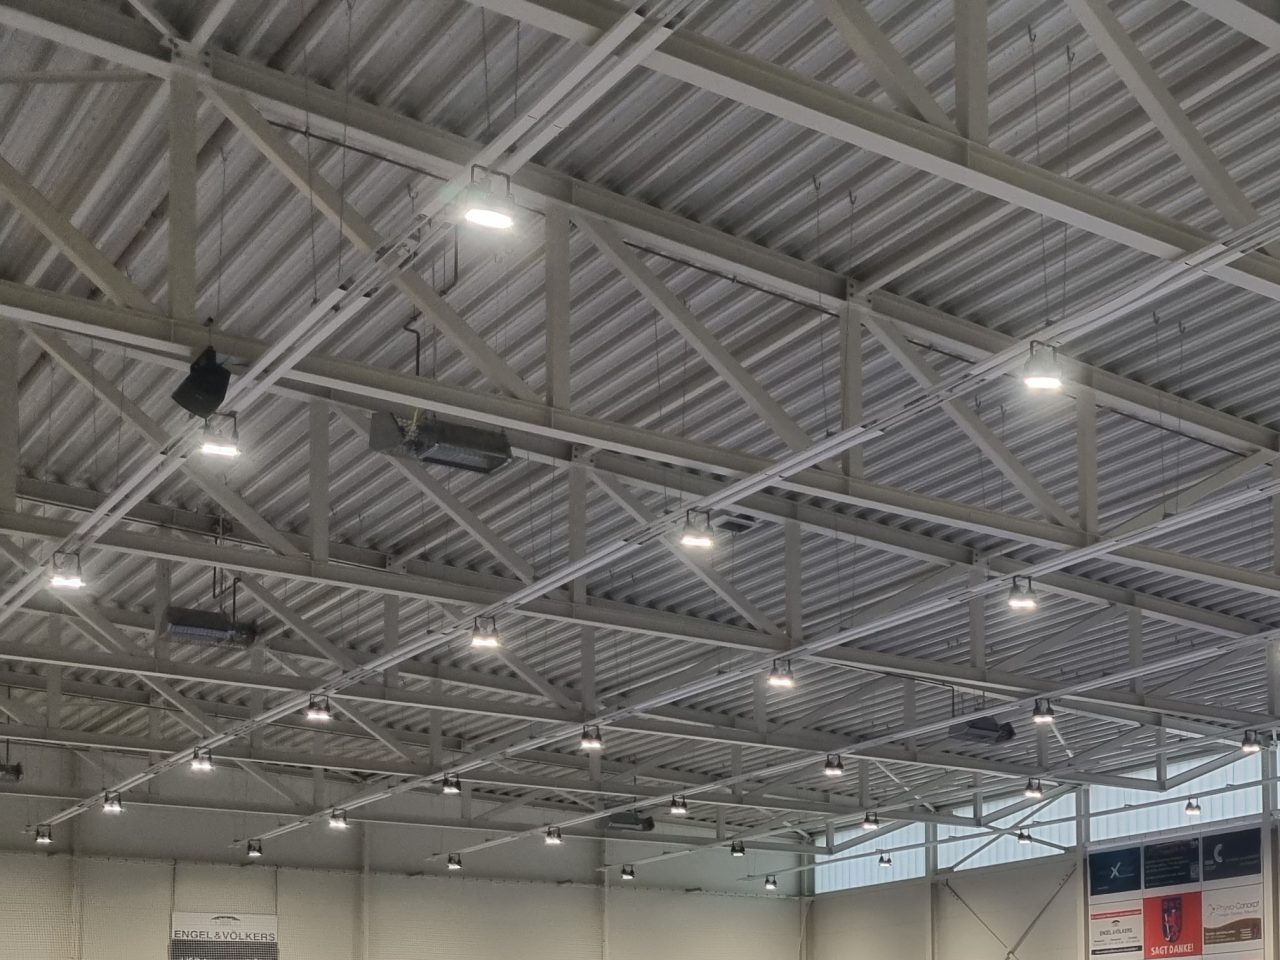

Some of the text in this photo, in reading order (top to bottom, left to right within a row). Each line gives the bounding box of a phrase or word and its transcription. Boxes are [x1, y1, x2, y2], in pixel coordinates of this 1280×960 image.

[174, 930, 213, 939] ENGEL
[1151, 943, 1194, 956] SAGT DANKE!
